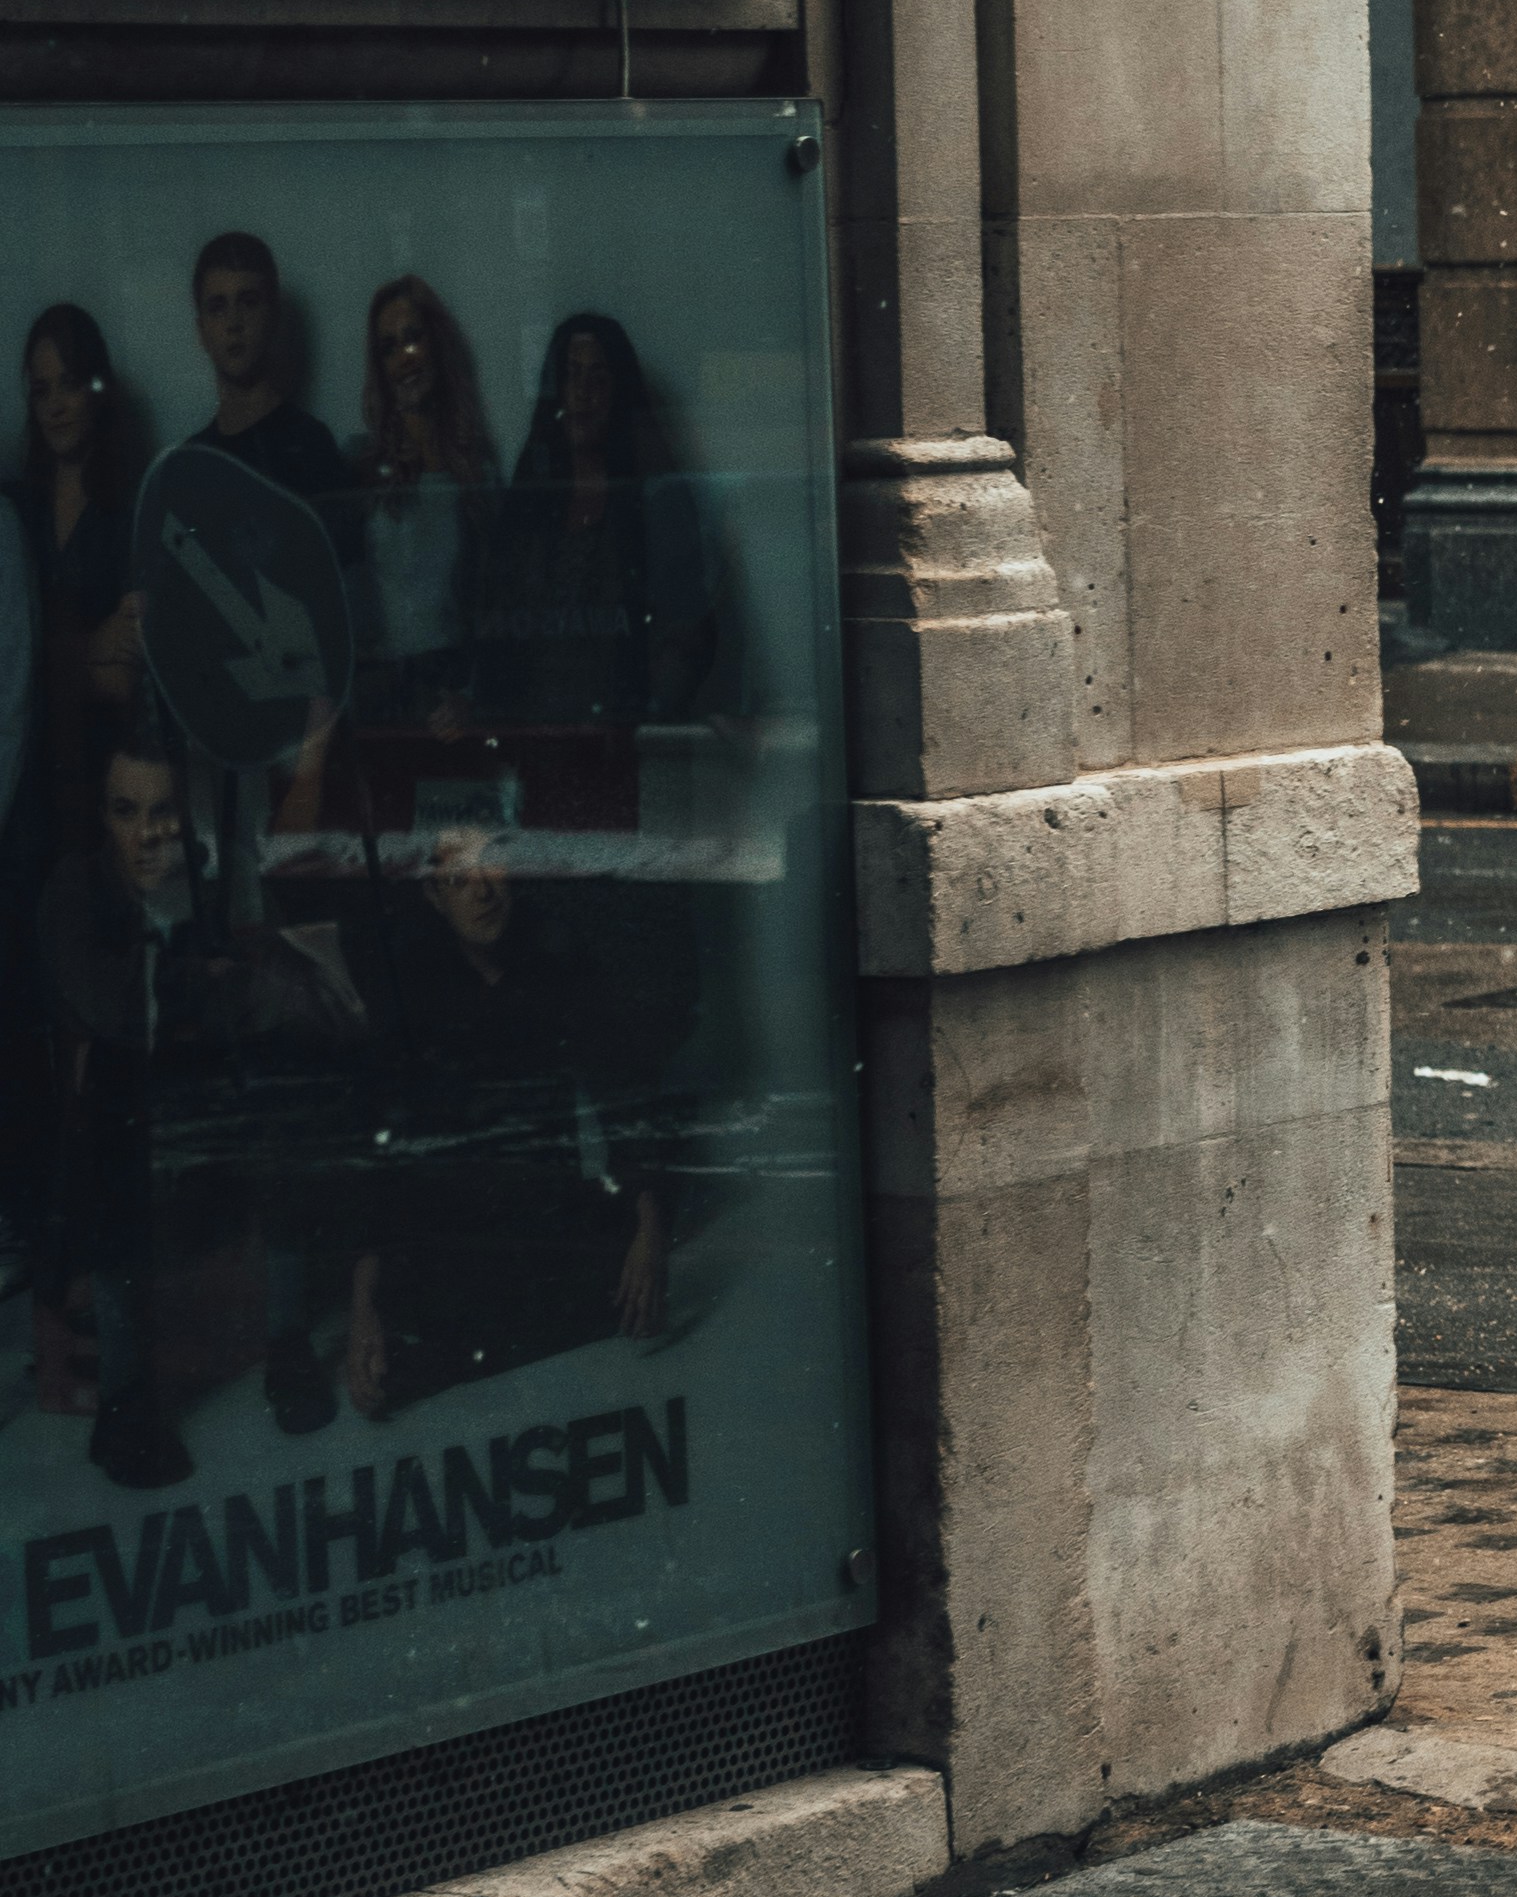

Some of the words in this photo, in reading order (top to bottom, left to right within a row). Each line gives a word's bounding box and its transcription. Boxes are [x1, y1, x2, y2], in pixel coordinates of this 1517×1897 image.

[51, 1604, 328, 1698] AWARD-WINNING
[340, 1579, 417, 1627] BEST
[430, 1545, 563, 1606] MUSICAL
